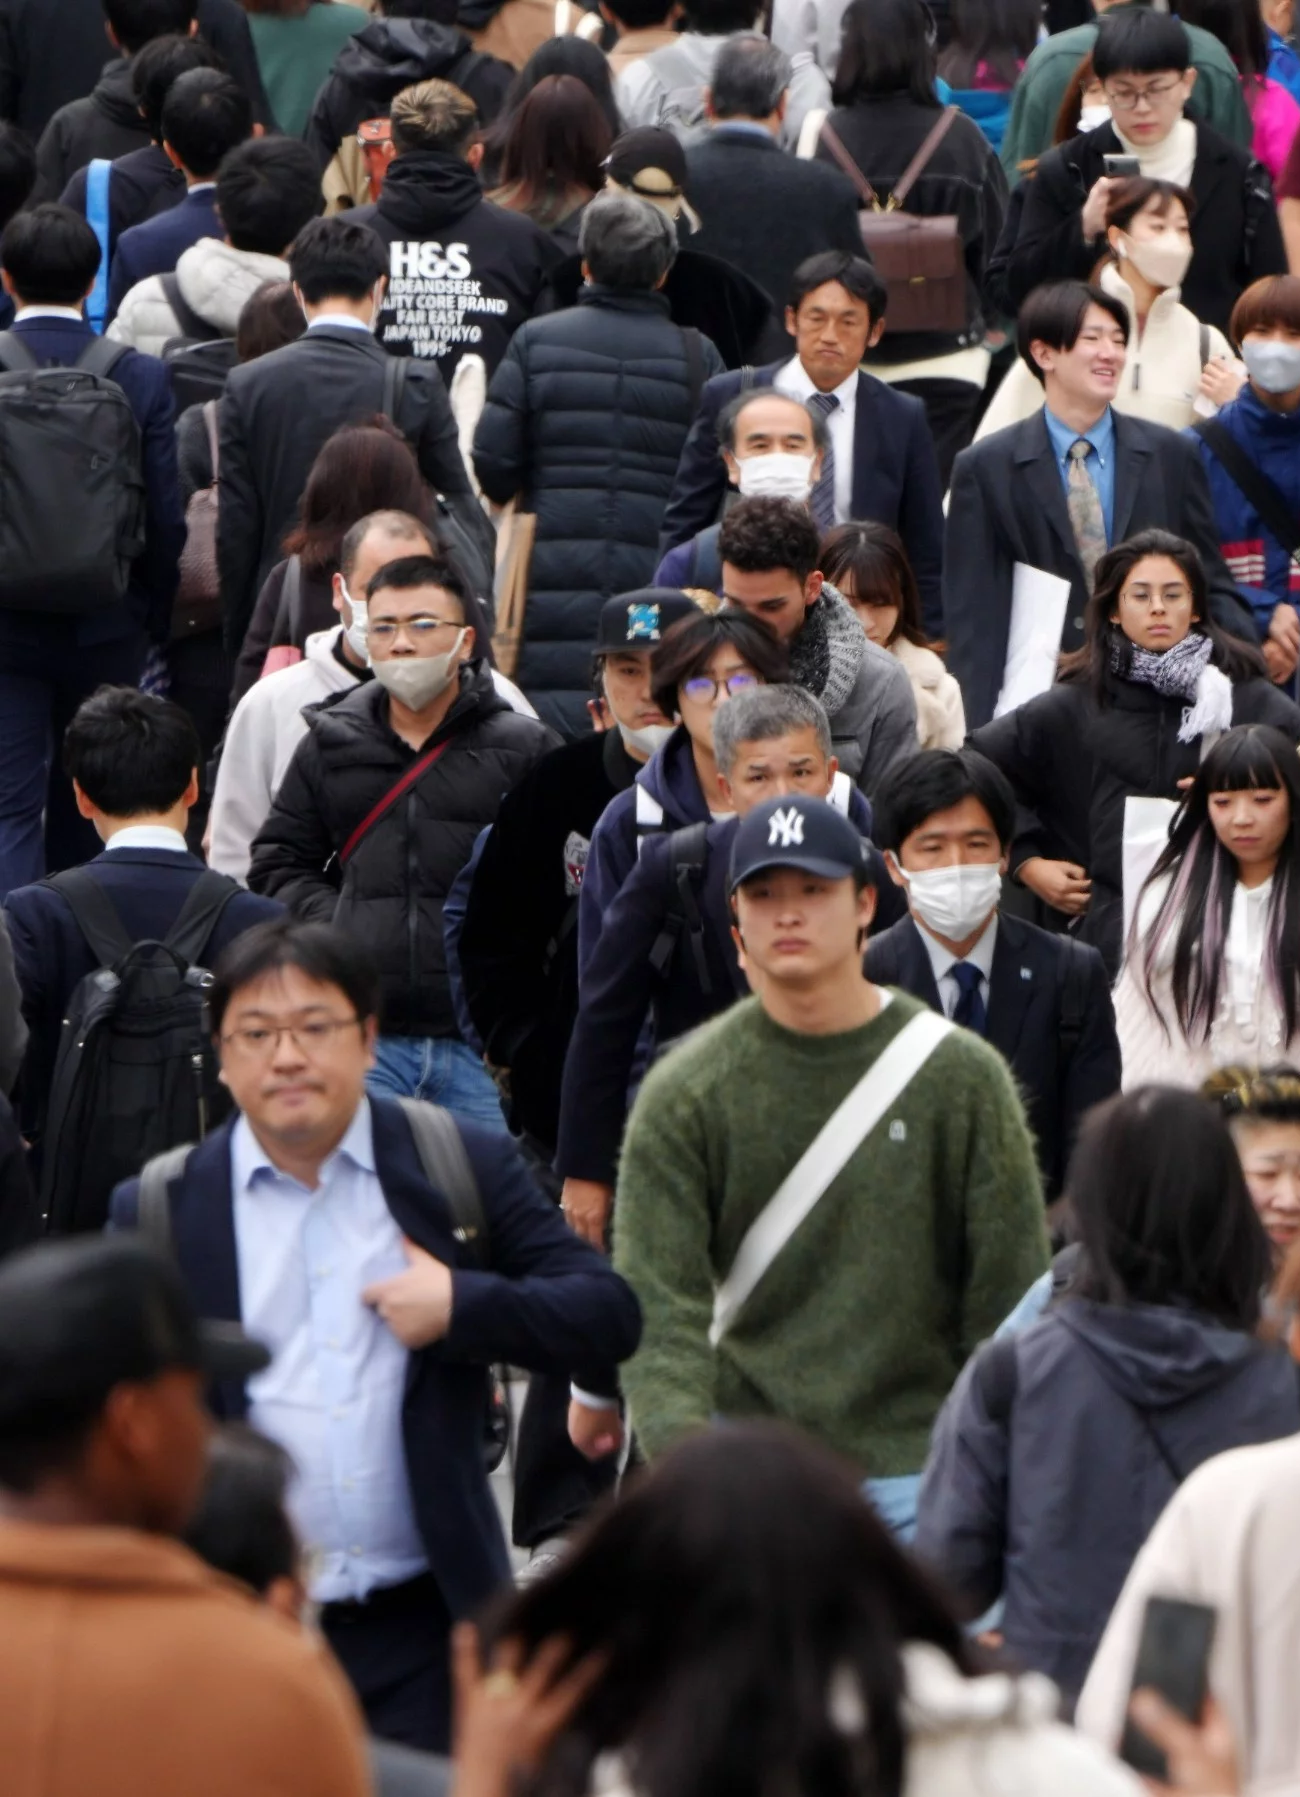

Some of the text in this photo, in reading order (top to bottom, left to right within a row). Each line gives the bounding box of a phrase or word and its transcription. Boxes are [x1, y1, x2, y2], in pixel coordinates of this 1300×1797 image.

[390, 241, 471, 279] H&S
[389, 279, 481, 296] IDEANDSEEK
[416, 295, 456, 311] CORE
[457, 296, 509, 317] BRAND
[397, 309, 465, 325] FAR EAST
[383, 325, 482, 343] JAPAN TOKYO
[767, 806, 805, 848] NY
